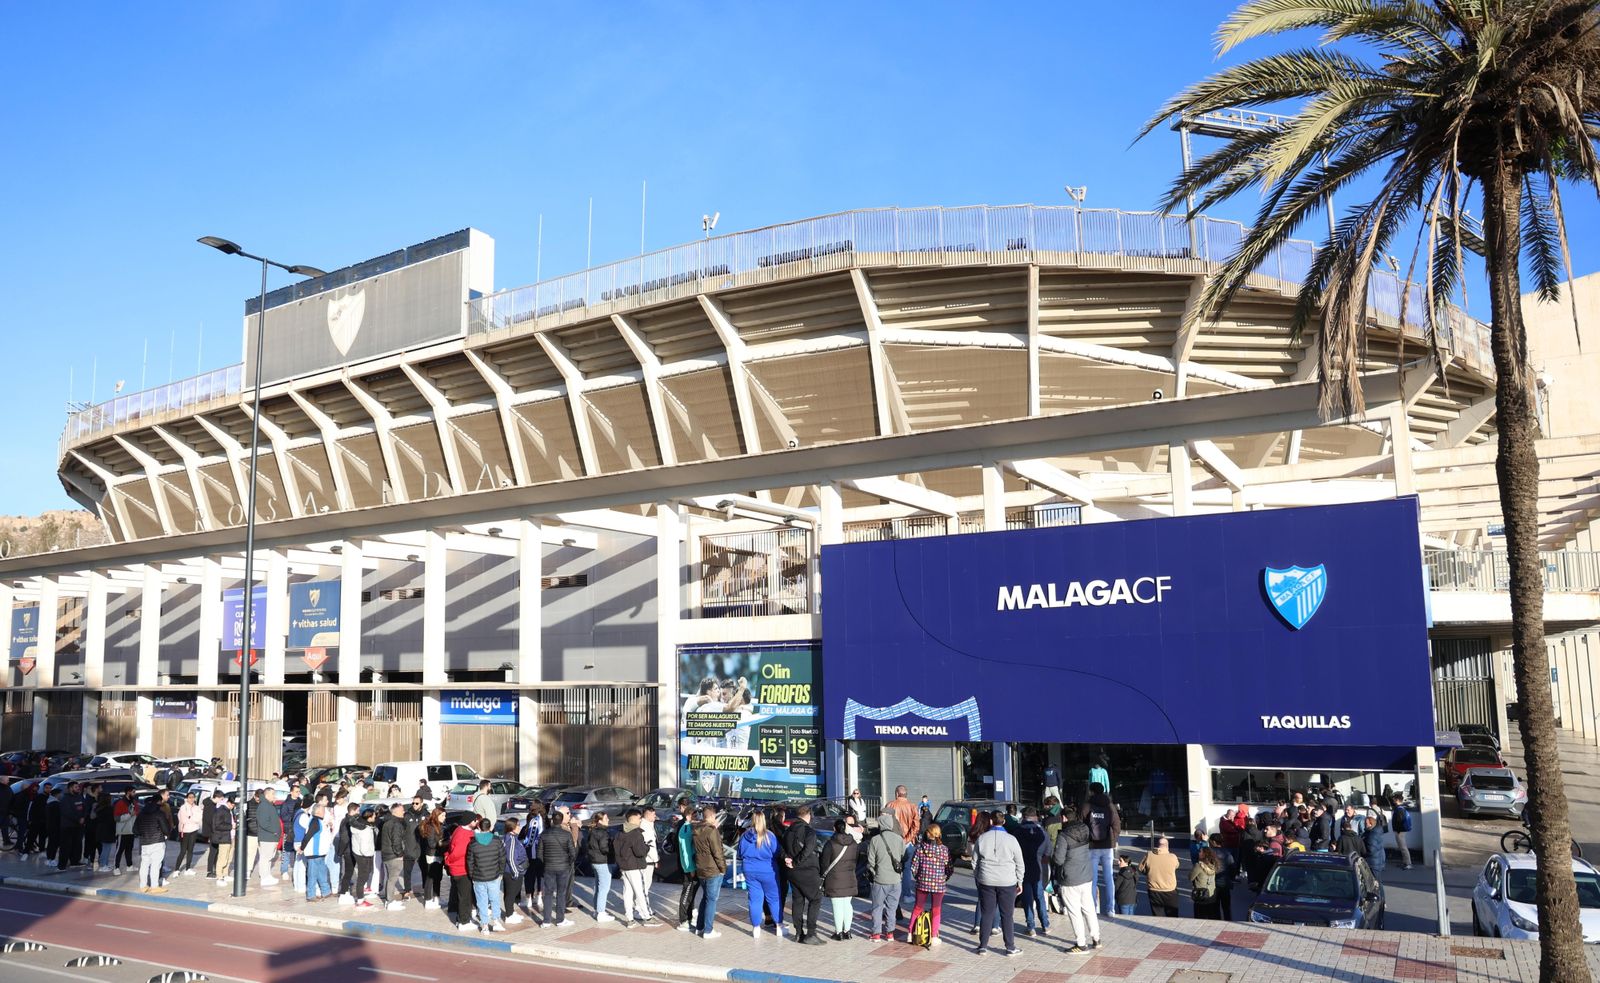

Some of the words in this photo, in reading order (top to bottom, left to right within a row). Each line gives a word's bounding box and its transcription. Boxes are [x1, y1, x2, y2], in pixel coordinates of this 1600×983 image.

[298, 619, 317, 628] vithas
[319, 617, 337, 627] salud
[762, 663, 791, 679] Olin
[760, 684, 811, 704] FOROFOS
[761, 707, 774, 715] DEL
[806, 707, 817, 715] CF
[1261, 715, 1351, 729] TAQUILLAS
[874, 726, 909, 735] TIENDA
[910, 726, 949, 735] OFICIAL
[760, 737, 778, 754] 15
[790, 738, 808, 755] 19
[700, 756, 714, 769] POR
[715, 756, 750, 770] USTEDES!
